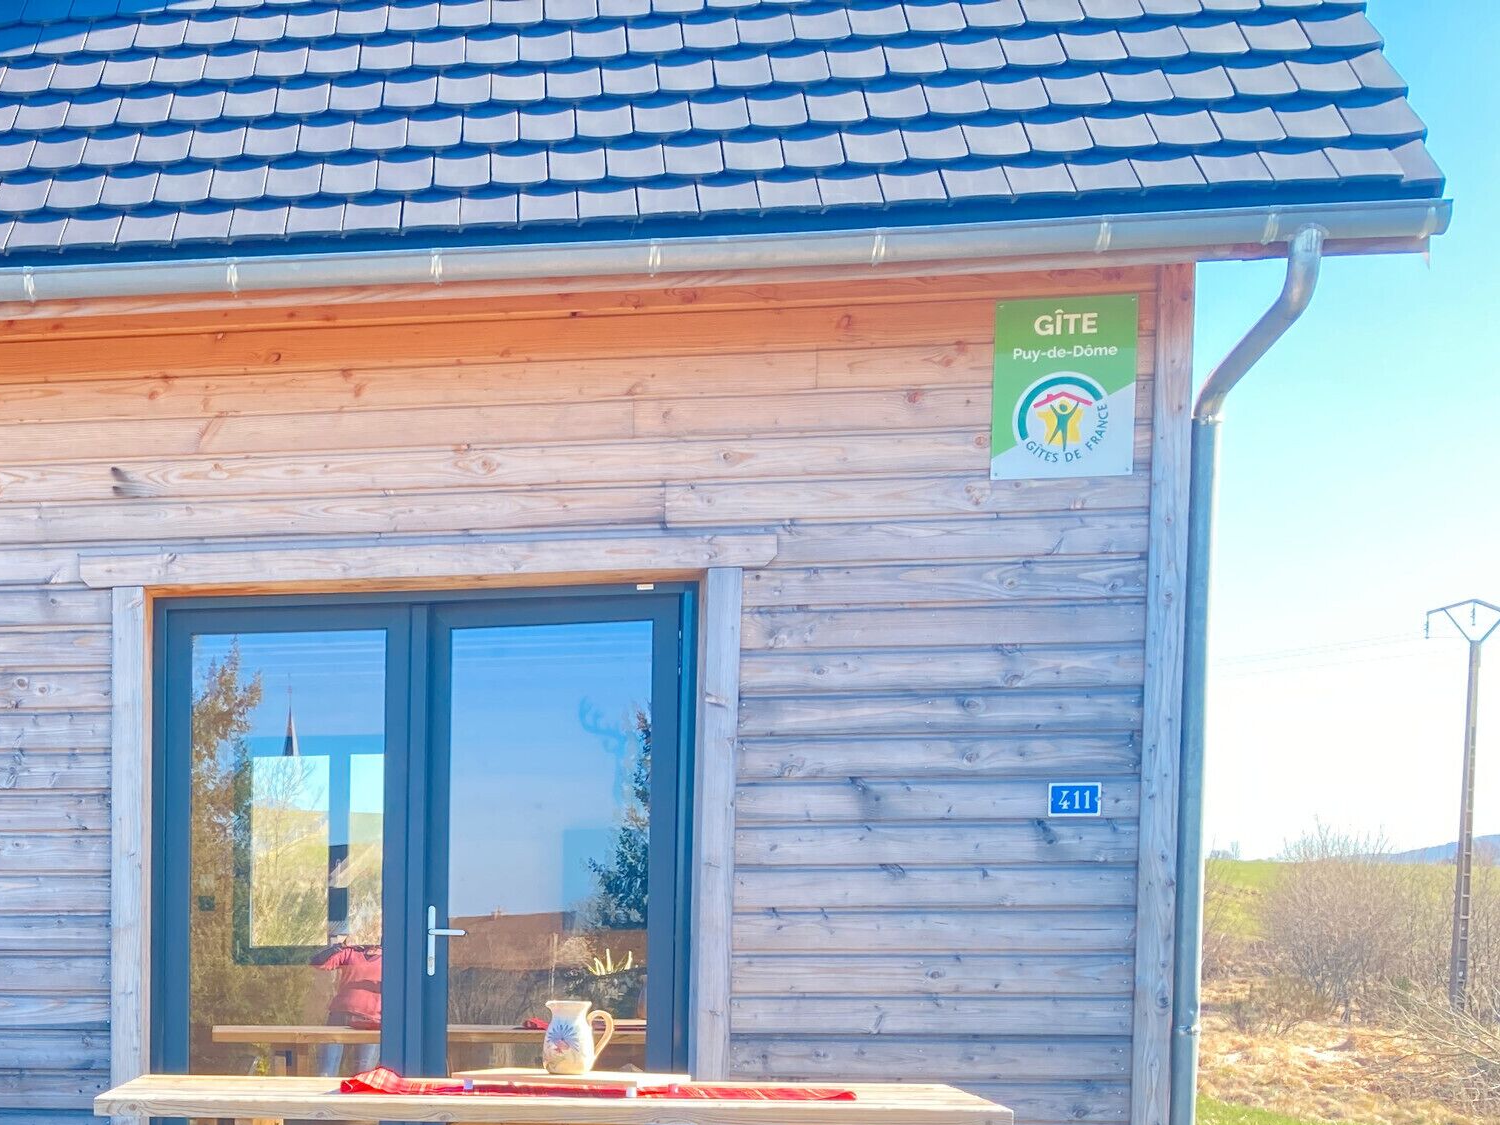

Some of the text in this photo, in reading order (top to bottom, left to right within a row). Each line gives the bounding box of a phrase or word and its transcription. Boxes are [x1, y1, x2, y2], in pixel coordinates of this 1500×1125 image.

[1033, 309, 1098, 336] GÎTE
[1013, 345, 1118, 363] Puy-de-Dôme
[1026, 404, 1109, 463] GÎTES DE FRANCE
[1058, 790, 1090, 810] 411
